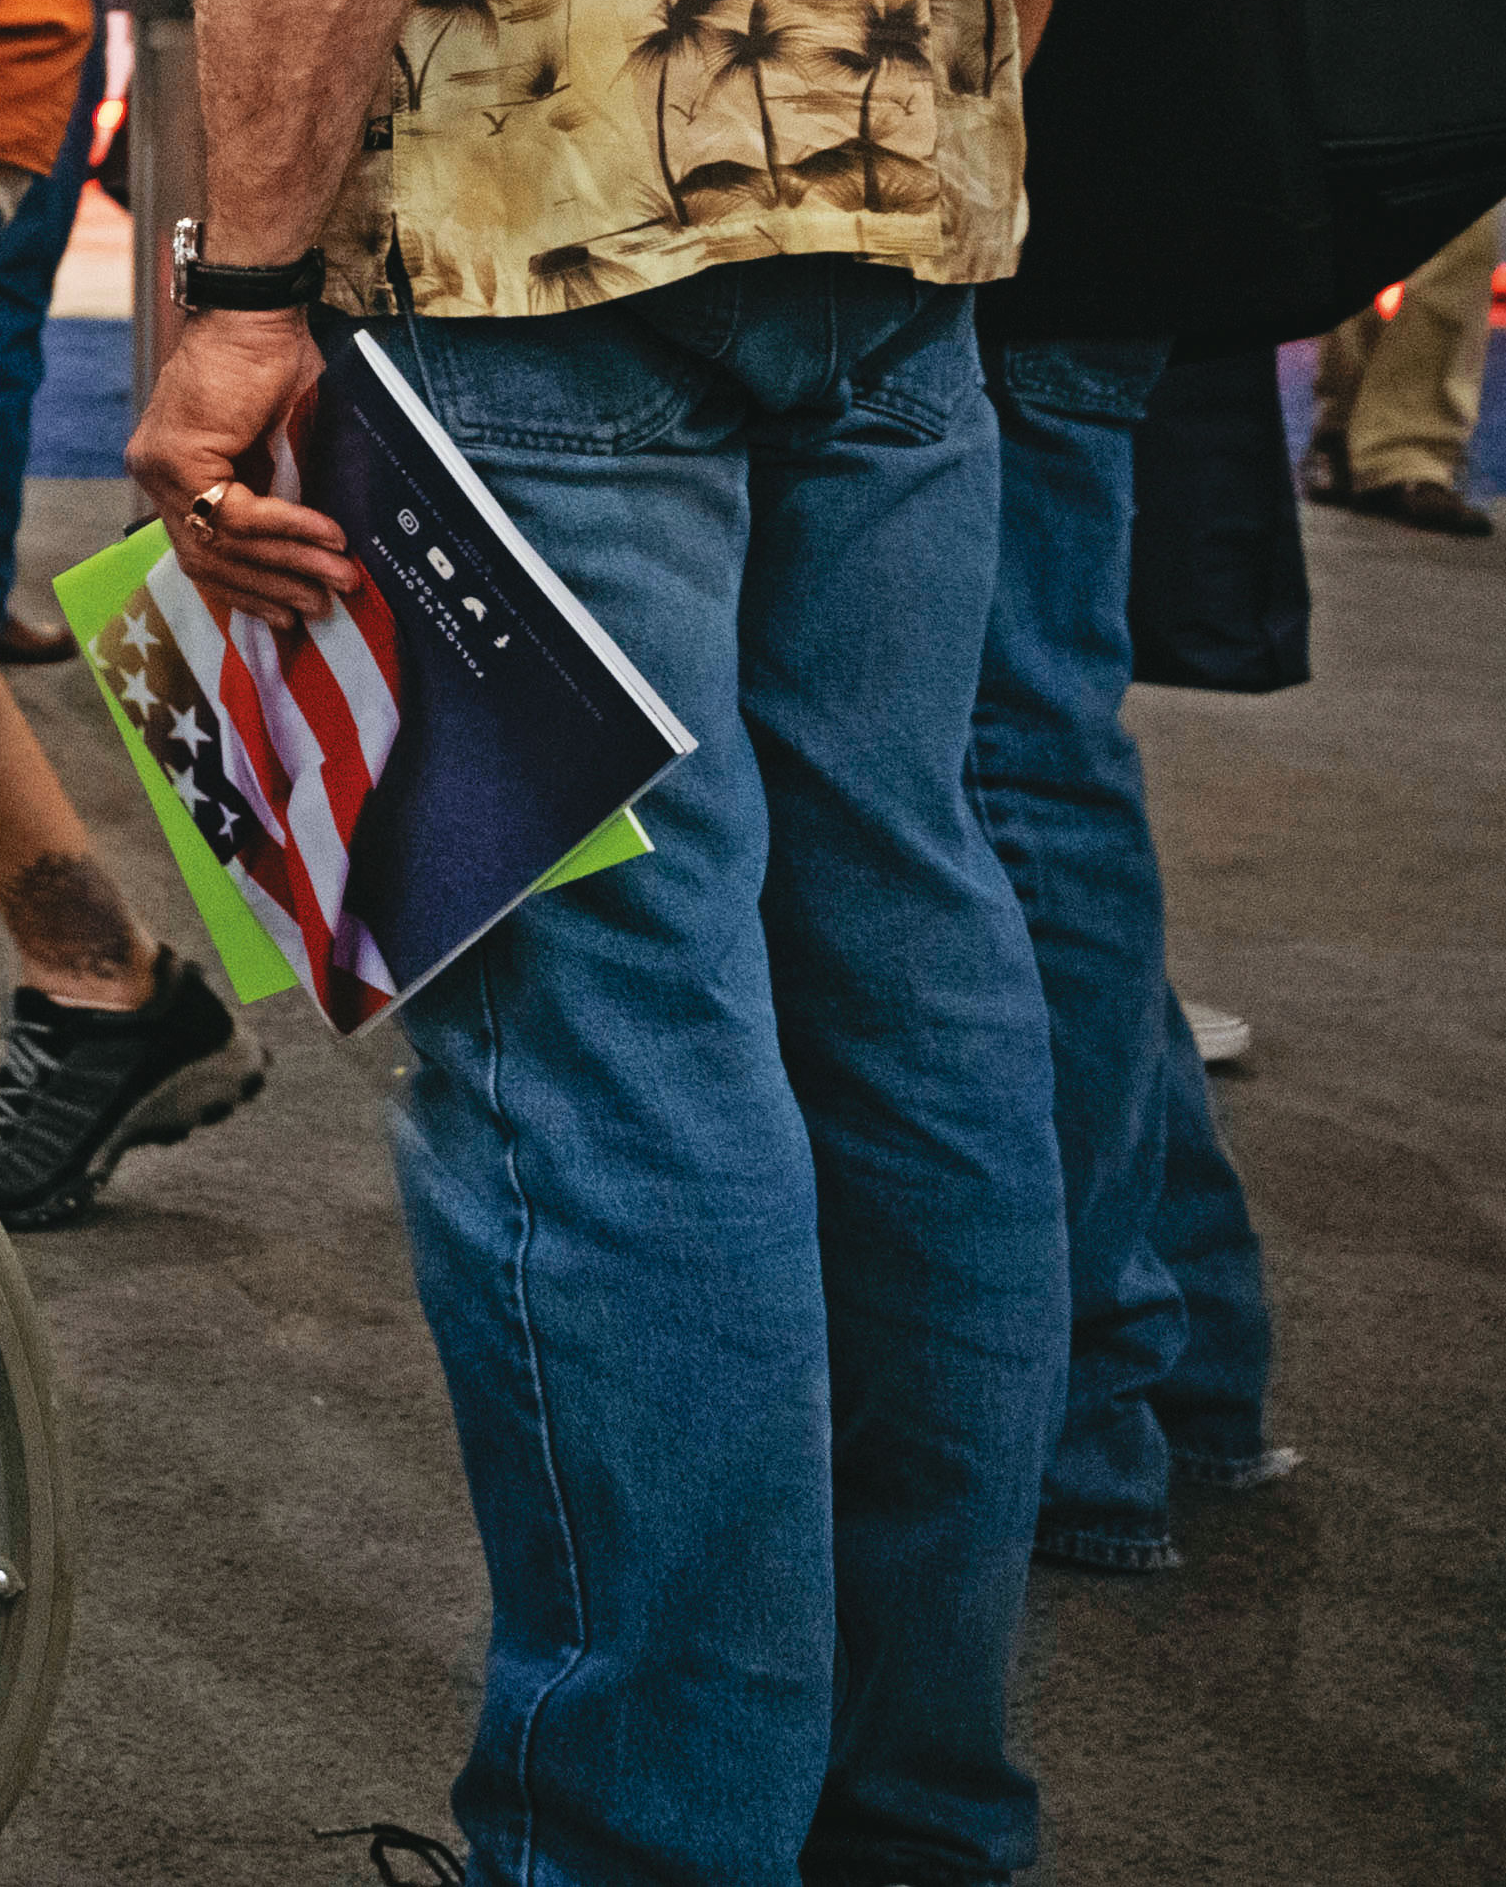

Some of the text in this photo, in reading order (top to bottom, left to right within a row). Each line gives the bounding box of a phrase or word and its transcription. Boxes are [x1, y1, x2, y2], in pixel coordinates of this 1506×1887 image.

[371, 535, 484, 679] FOLLOW US ONLINE
[408, 566, 461, 632] NRA.ORG
